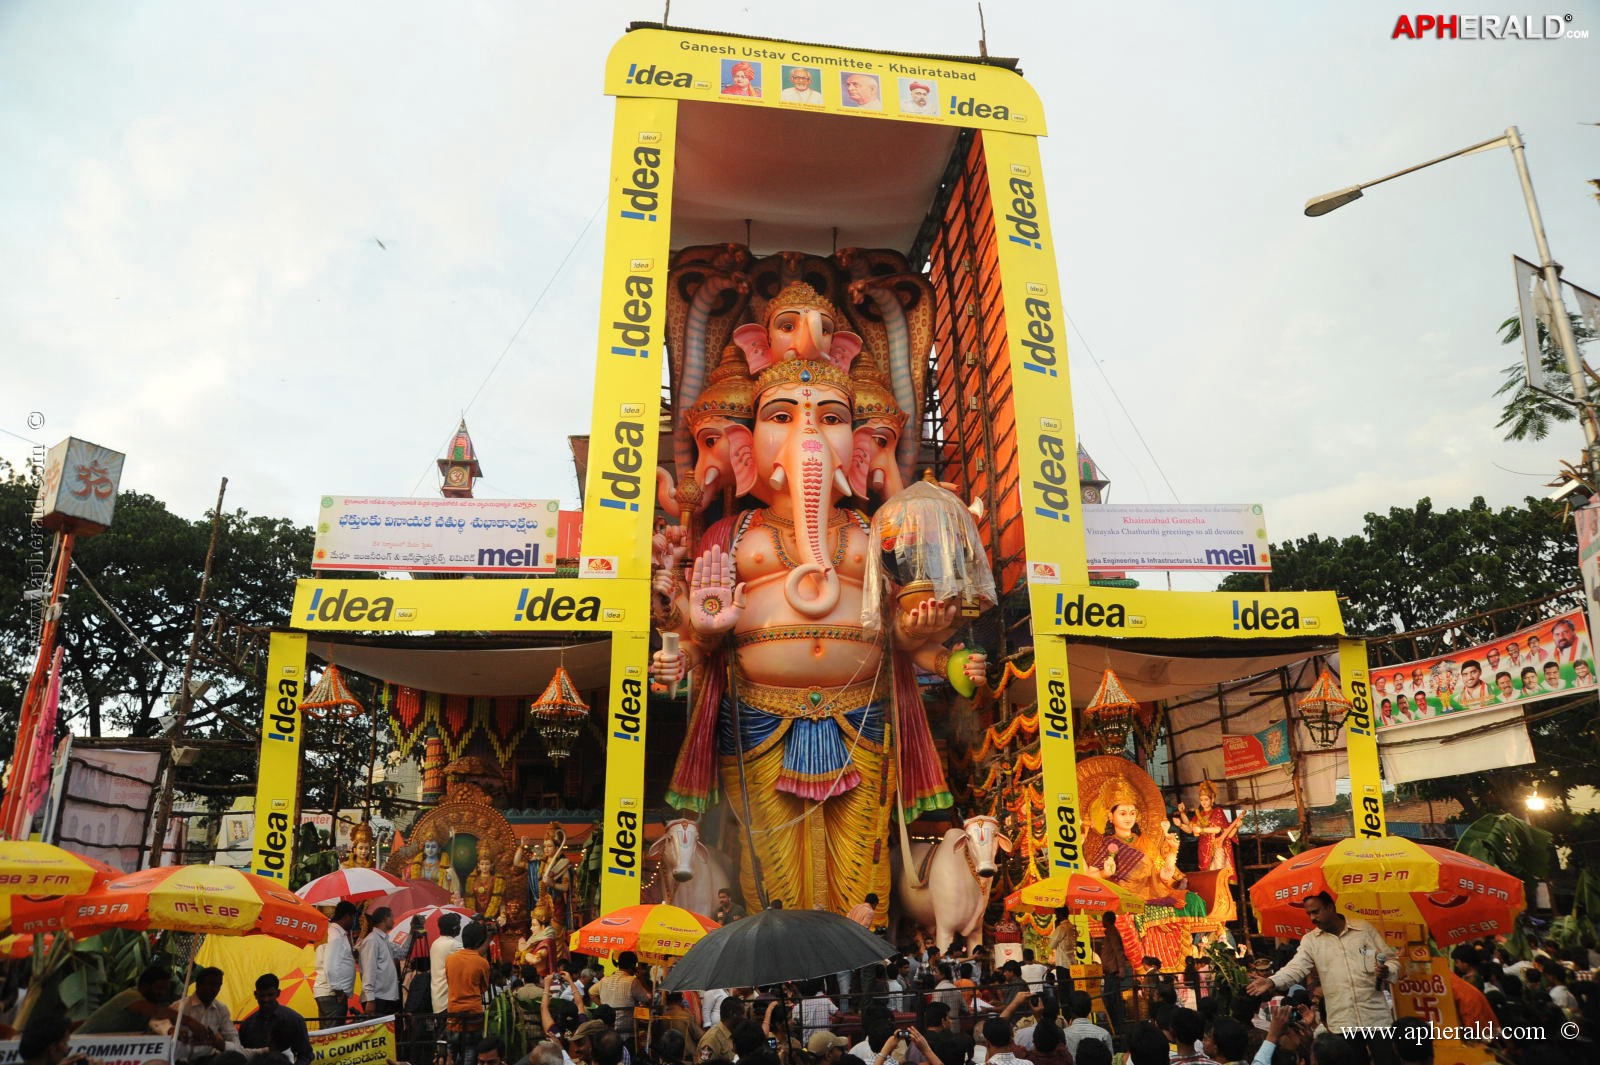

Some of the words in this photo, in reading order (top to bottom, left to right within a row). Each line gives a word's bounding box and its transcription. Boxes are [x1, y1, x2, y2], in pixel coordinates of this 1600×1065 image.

[680, 40, 736, 55] Ganesh
[742, 48, 786, 60] Ustav
[791, 52, 873, 70] Committee
[889, 63, 977, 81] Khairatabad
[1171, 516, 1206, 524] Ganesha
[1086, 528, 1120, 537] Vinayaka
[1161, 528, 1194, 537] greetings
[1204, 528, 1213, 536] all
[1214, 527, 1244, 536] devotees
[478, 543, 539, 567] meil
[1103, 557, 1139, 566] Engineering
[1147, 557, 1192, 565] Infrastructures
[1205, 544, 1256, 566] meil
[77, 1042, 164, 1057] COMMITTEE
[329, 1036, 387, 1058] COUNTER
